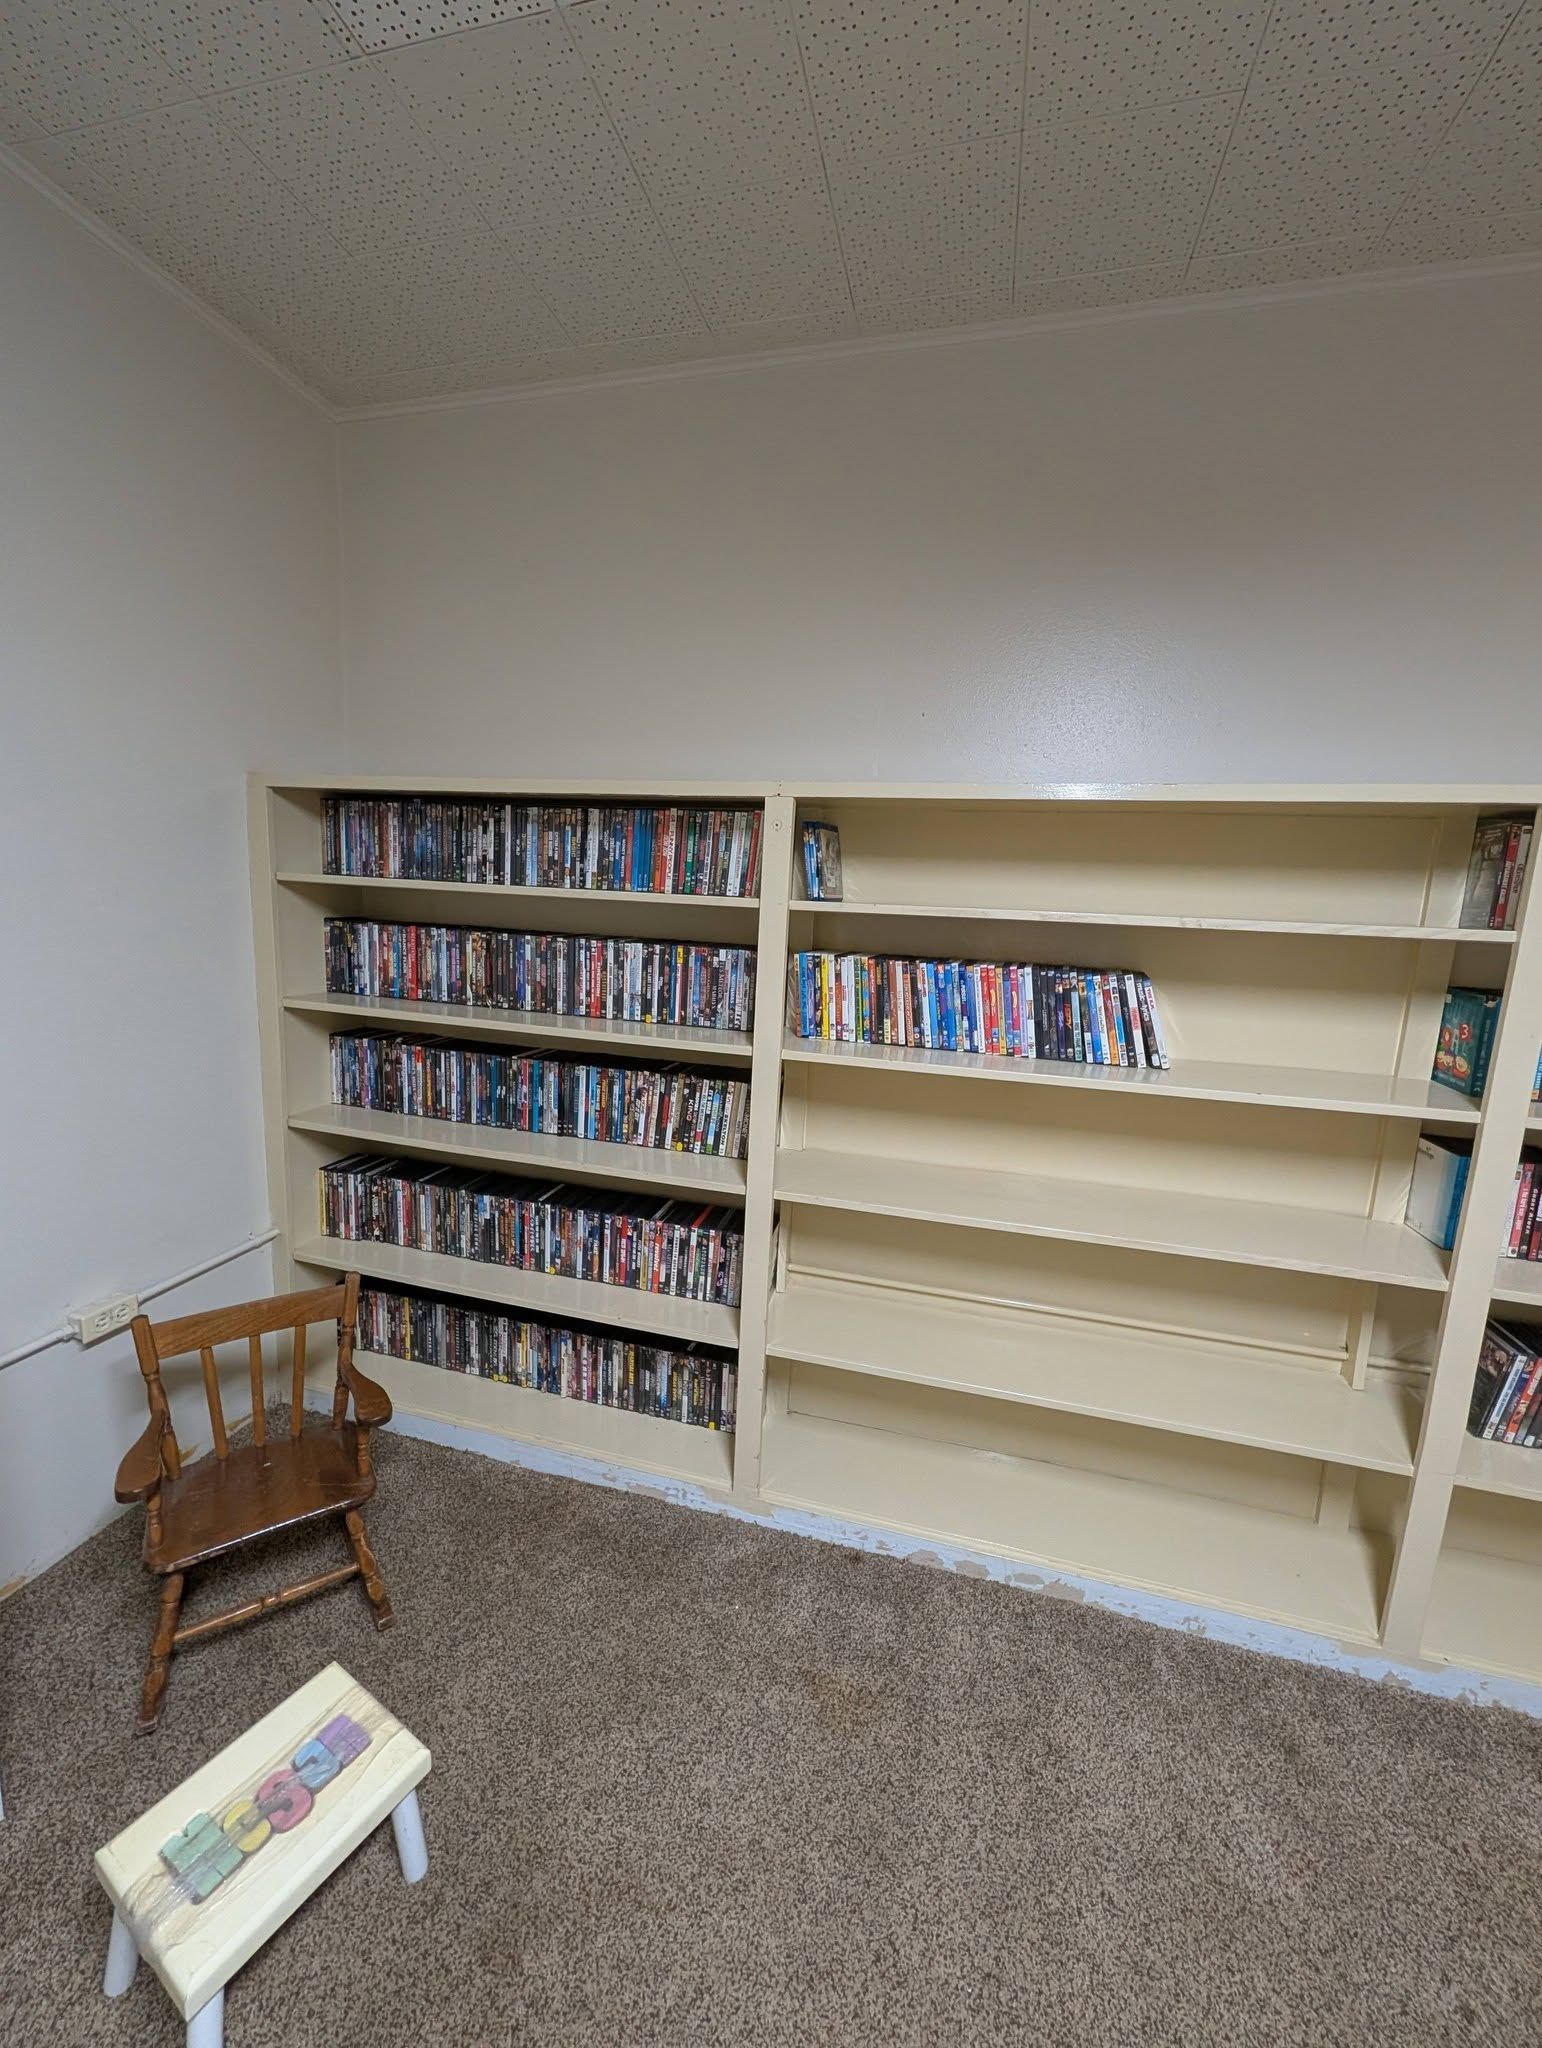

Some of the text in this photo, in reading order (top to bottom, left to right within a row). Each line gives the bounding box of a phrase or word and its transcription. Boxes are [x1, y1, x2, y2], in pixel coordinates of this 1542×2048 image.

[1461, 1024, 1469, 1039] 3
[1525, 1188, 1538, 1235] GHOST RIDER
